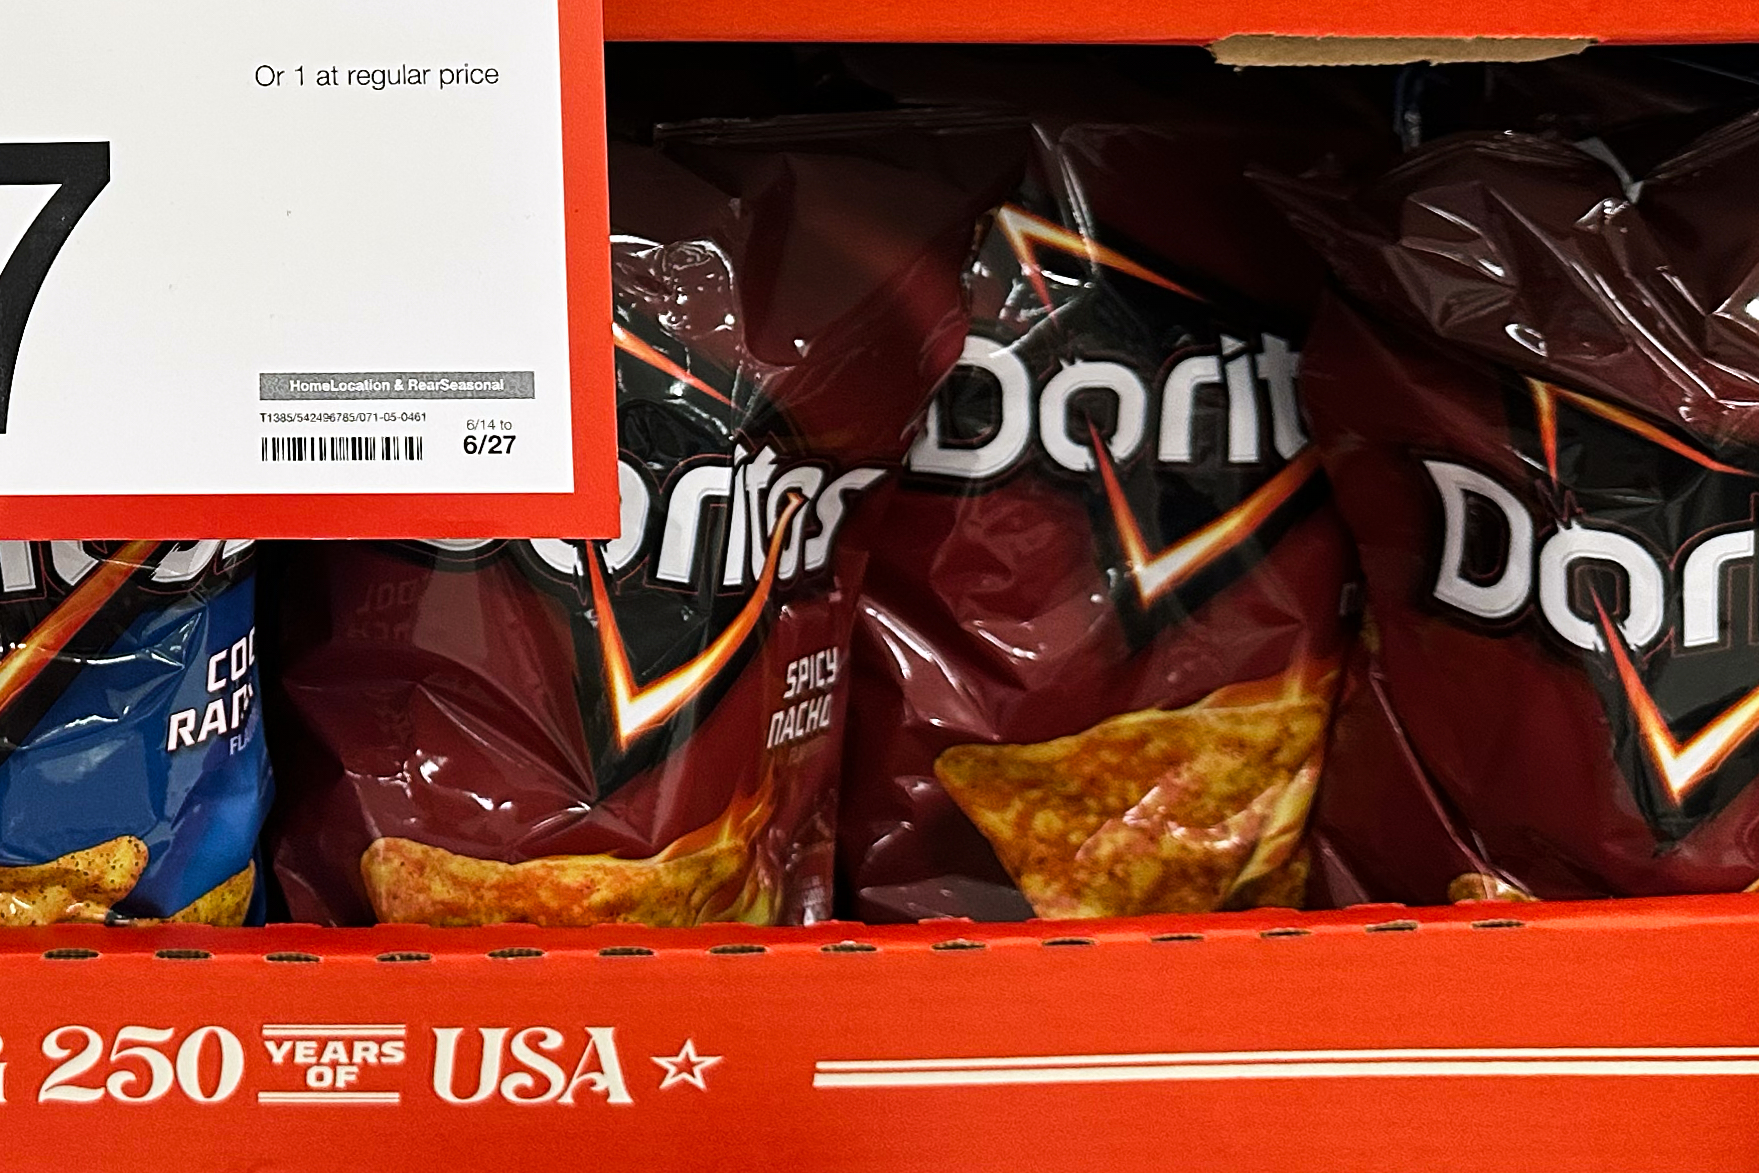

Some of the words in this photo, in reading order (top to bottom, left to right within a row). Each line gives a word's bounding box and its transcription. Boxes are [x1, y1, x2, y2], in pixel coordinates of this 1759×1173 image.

[254, 64, 285, 88] Or
[294, 65, 305, 87] 1
[316, 65, 340, 87] at
[347, 62, 431, 91] regular
[438, 63, 500, 92] price
[289, 379, 391, 392] HomeLocation
[394, 379, 405, 391] &
[408, 378, 504, 392] RearSeasonal
[906, 331, 1311, 480] Dorit
[463, 435, 516, 455] 6/27
[466, 419, 496, 431] 6/14
[500, 419, 512, 430] to
[529, 443, 889, 587] oritos
[783, 646, 840, 699] SPICY
[767, 693, 833, 749] NACHO
[39, 1024, 245, 1106] 250
[265, 1040, 406, 1064] YEARS
[431, 1025, 635, 1106] USA
[305, 1064, 356, 1089] OF
